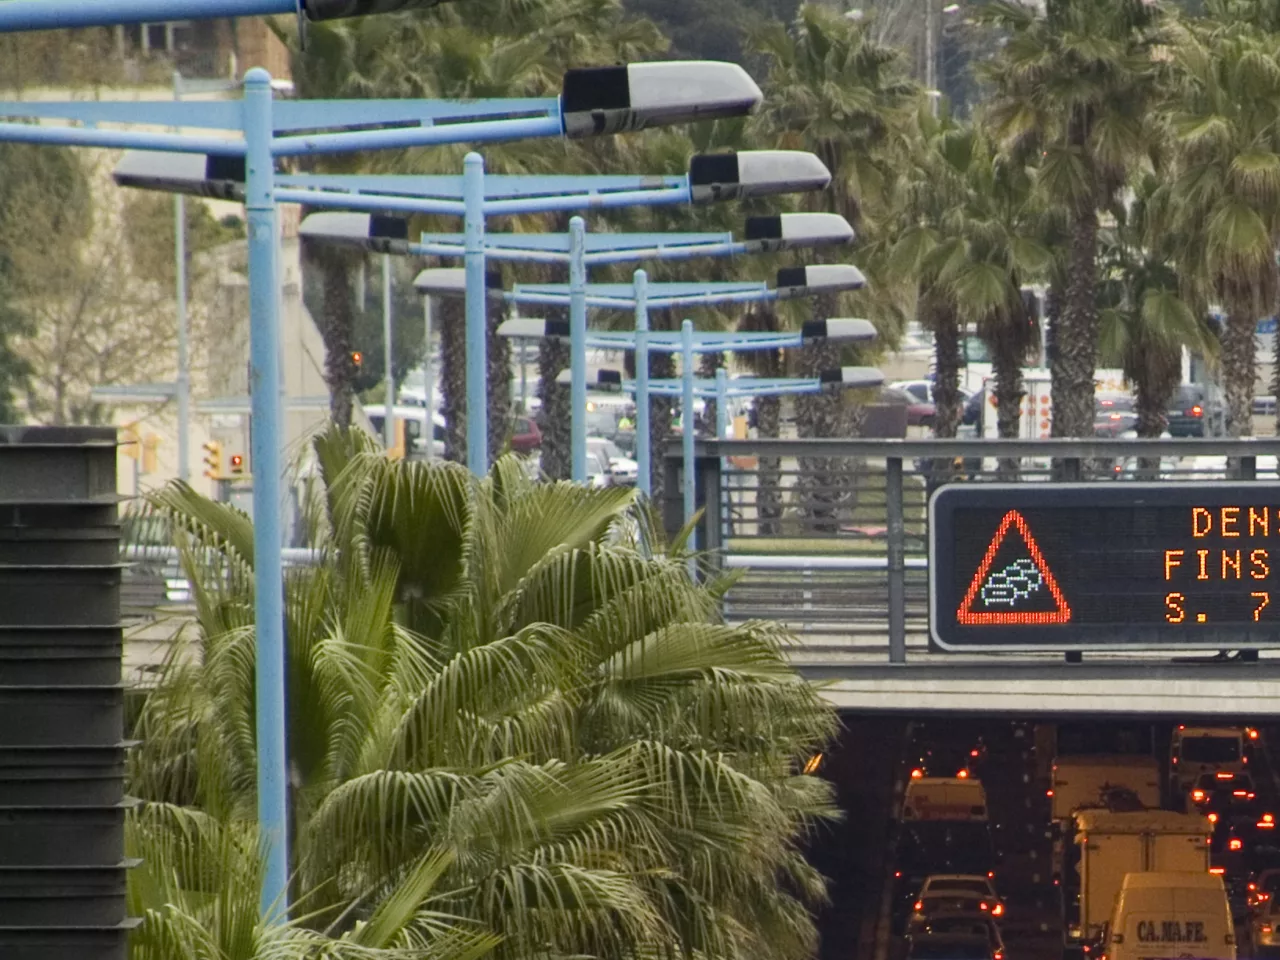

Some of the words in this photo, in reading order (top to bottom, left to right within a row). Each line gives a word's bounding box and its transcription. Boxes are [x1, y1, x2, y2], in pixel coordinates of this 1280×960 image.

[1165, 550, 1270, 580] FINS
[1165, 592, 1207, 623] S.
[1250, 592, 1270, 622] 7
